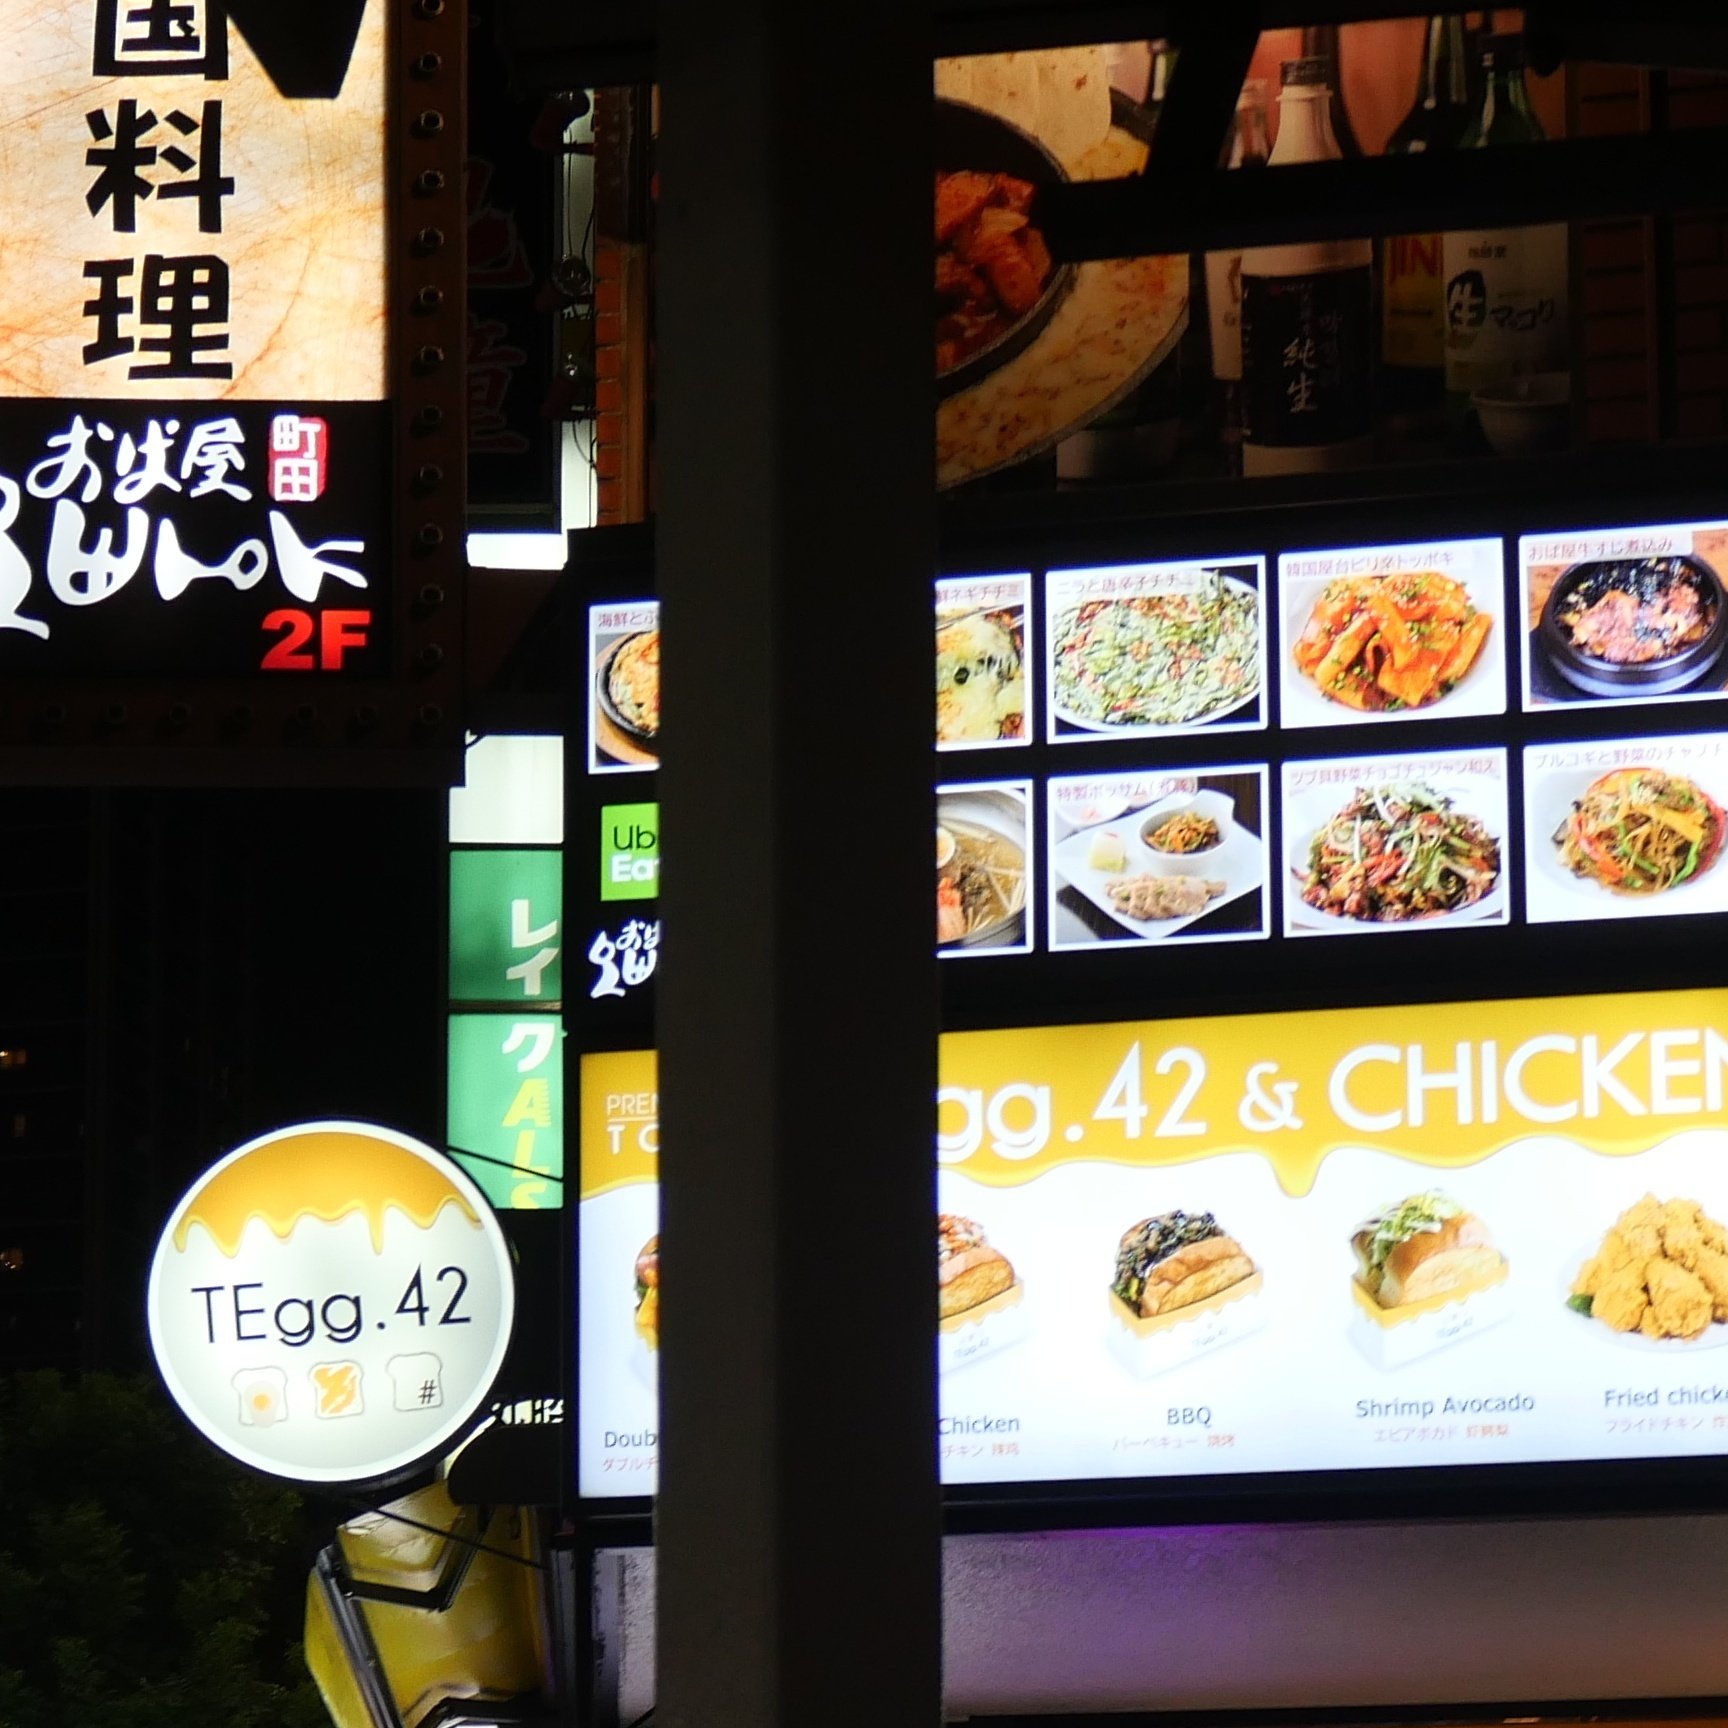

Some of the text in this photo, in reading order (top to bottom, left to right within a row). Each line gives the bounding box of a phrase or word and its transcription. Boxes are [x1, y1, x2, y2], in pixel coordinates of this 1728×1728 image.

[272, 415, 322, 501] 町田
[261, 609, 371, 670] 2F
[606, 1092, 658, 1117] PRE
[1238, 1060, 1304, 1132] &
[190, 1263, 472, 1348] TEgg.42
[1355, 1393, 1536, 1420] Shrimp Avocado
[1604, 1386, 1659, 1409] Fried
[939, 1415, 1021, 1436] Chicken
[1167, 1406, 1213, 1429] BBQ
[603, 1428, 658, 1450] Doub
